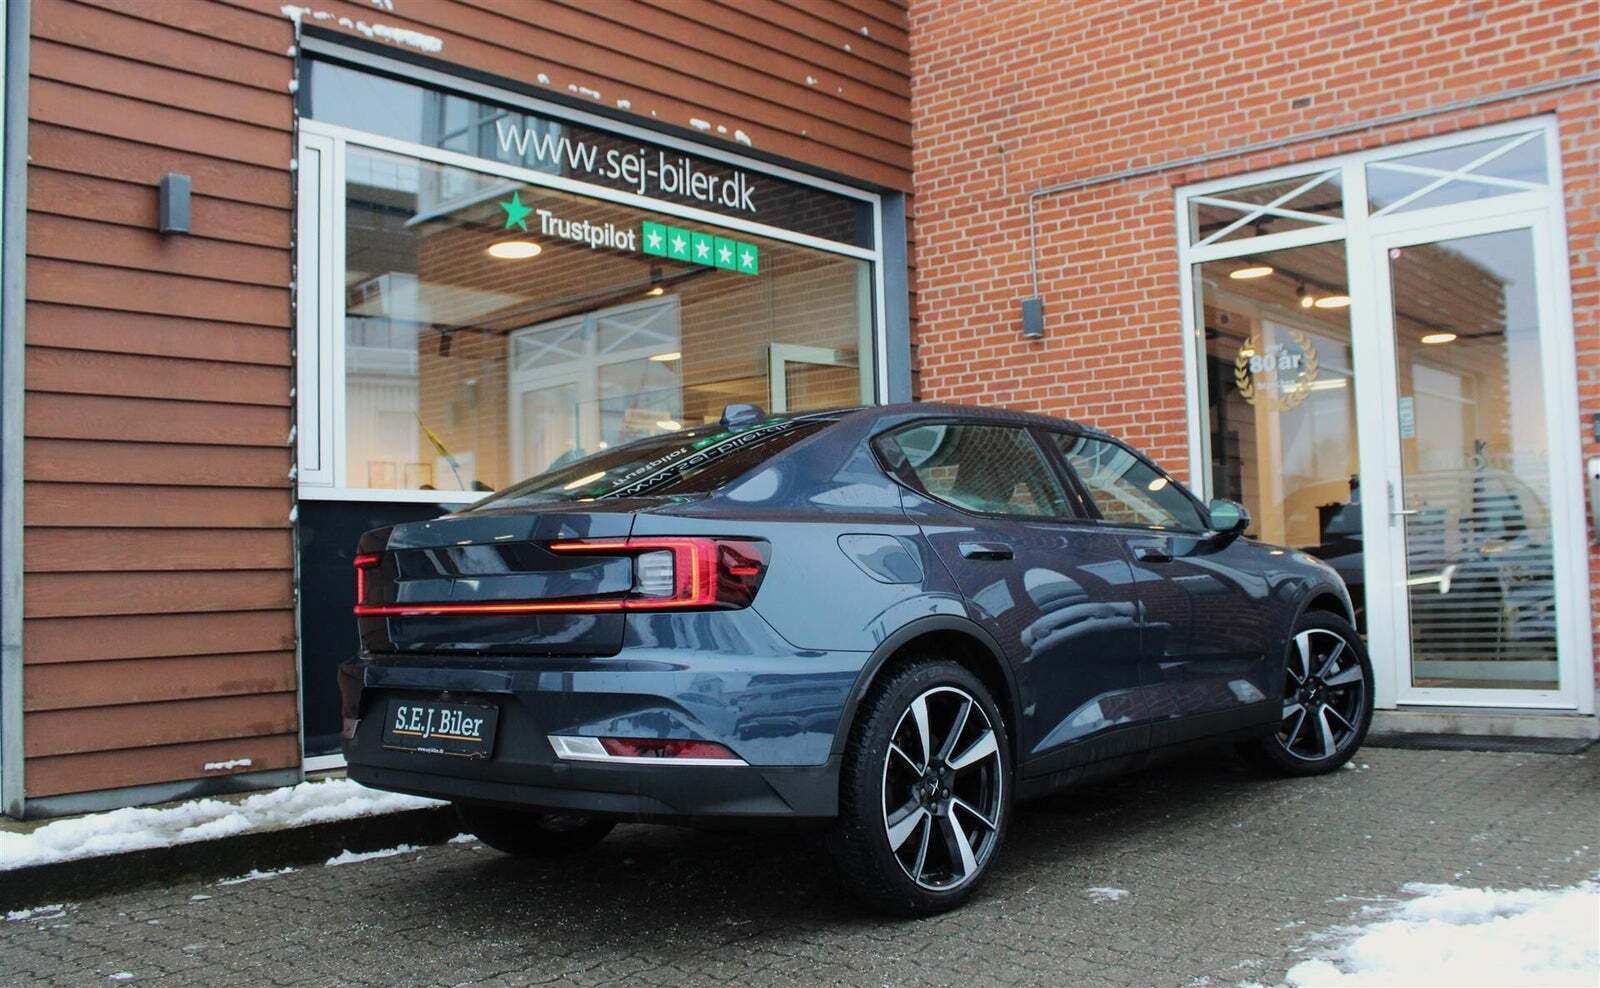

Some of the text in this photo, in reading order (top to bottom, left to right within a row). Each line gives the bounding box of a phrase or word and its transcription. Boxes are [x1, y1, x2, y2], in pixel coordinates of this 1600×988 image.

[495, 120, 757, 213] www.sej-biler.dk
[536, 208, 637, 252] Trustpilot
[1249, 349, 1302, 373] 80 år
[395, 706, 483, 738] S.E.J. Biler
